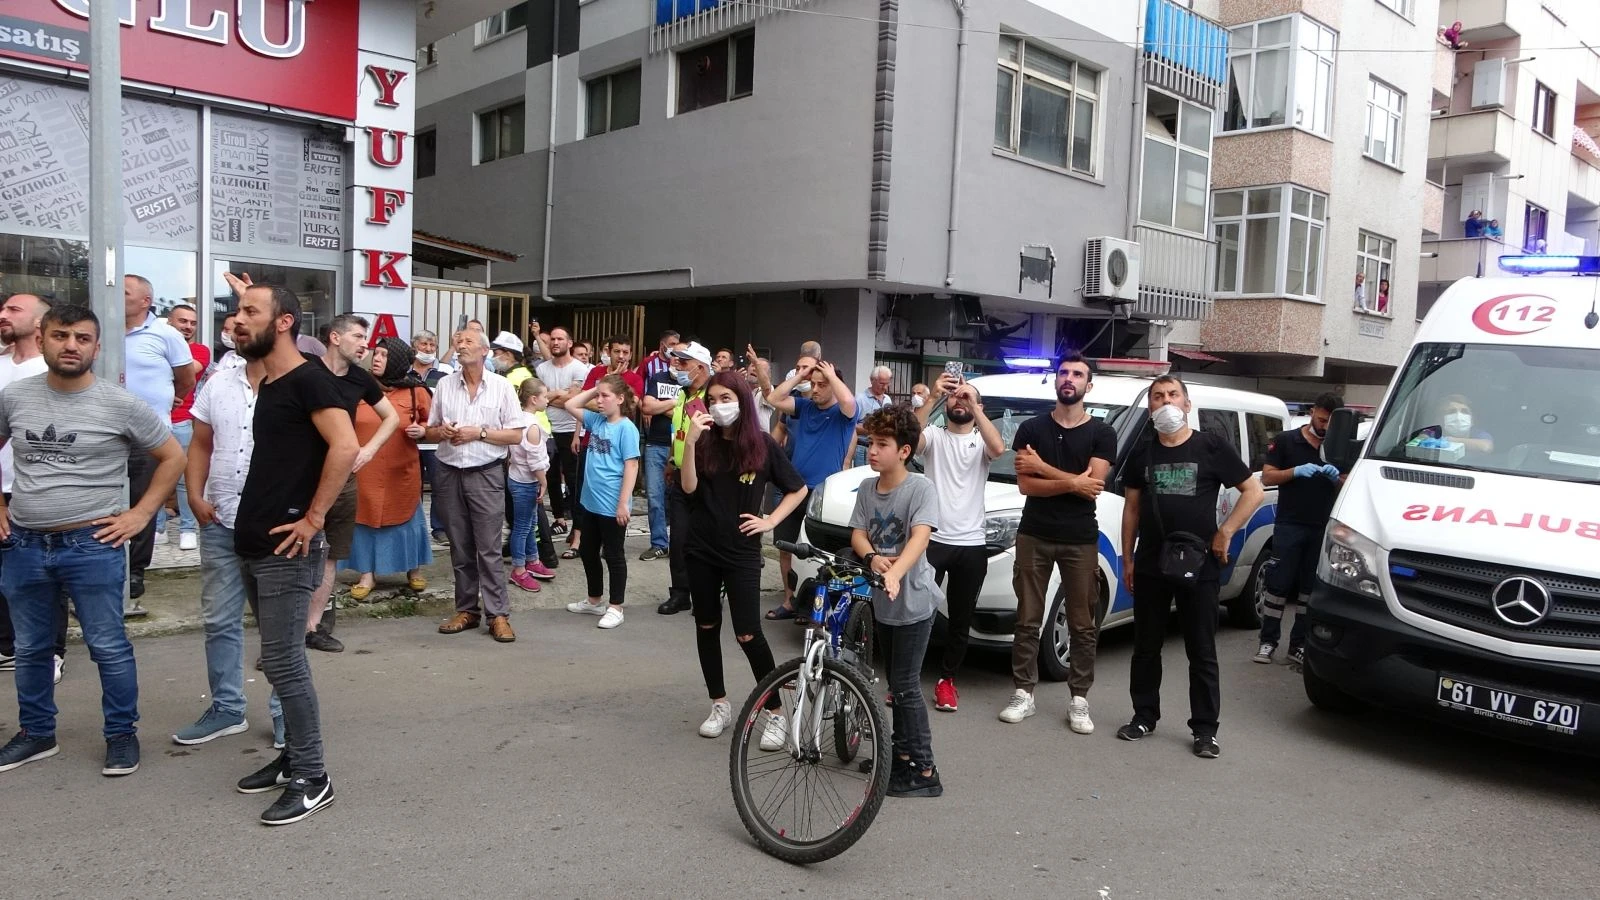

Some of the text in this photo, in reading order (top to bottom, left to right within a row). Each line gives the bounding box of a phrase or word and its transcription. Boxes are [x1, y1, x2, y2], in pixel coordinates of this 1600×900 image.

[0, 25, 80, 62] satış
[223, 132, 246, 148] Siron
[256, 128, 269, 176] YUFKA
[2, 160, 42, 179] HAS
[221, 161, 255, 172] HAS
[304, 163, 340, 176] ERISTE
[2, 171, 69, 200] GAZIOGLU
[211, 175, 270, 191] GAZIOGLU
[306, 176, 340, 189] Siron
[124, 183, 167, 205] YUFKA
[36, 200, 87, 227] ERISTE
[136, 195, 177, 219] ERISTE
[212, 188, 226, 242] ERISTE
[226, 206, 271, 220] ERISTE
[303, 209, 339, 221] ERISTE
[303, 222, 340, 236] YUFKA
[305, 236, 339, 249] ERISTE
[1495, 304, 1556, 322] 112
[25, 452, 77, 464] adidas
[1451, 683, 1573, 727] 61 VV 670
